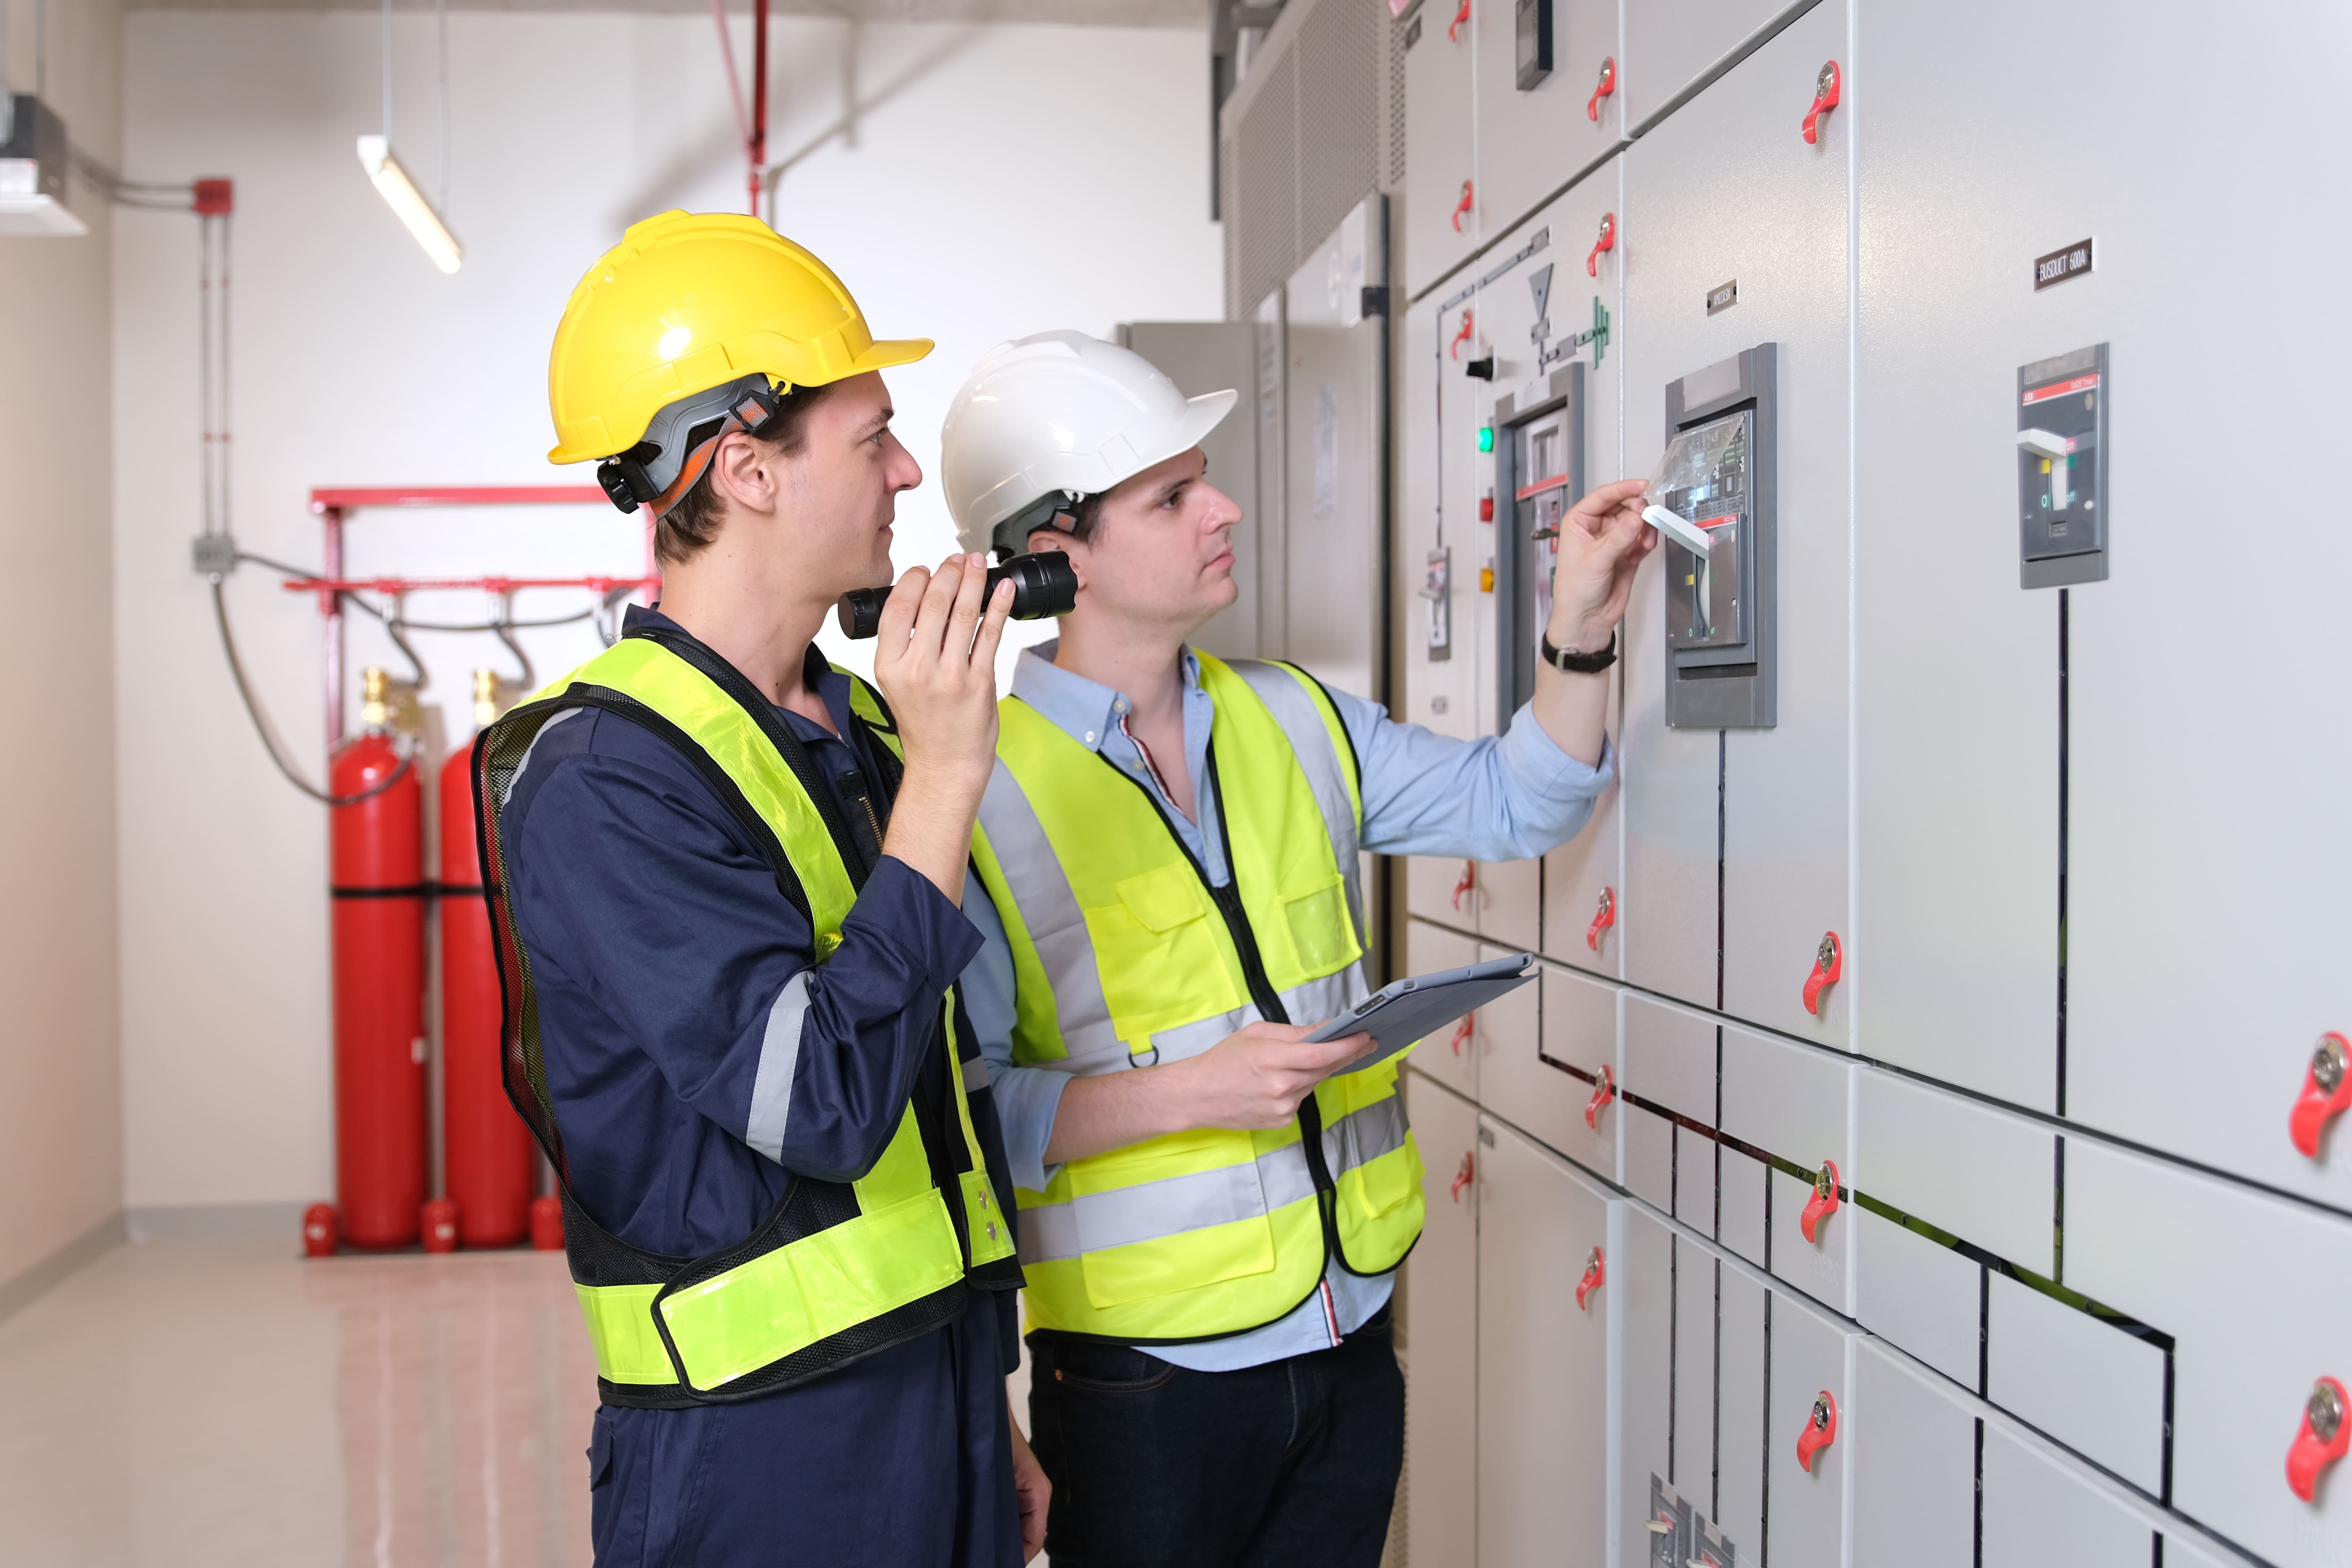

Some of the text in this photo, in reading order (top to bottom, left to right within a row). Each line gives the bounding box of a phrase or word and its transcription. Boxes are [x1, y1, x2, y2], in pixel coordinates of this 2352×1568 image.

[2040, 249, 2086, 282] BUSDUCT 600A
[2024, 392, 2033, 402] ABB
[2066, 491, 2075, 502] off
